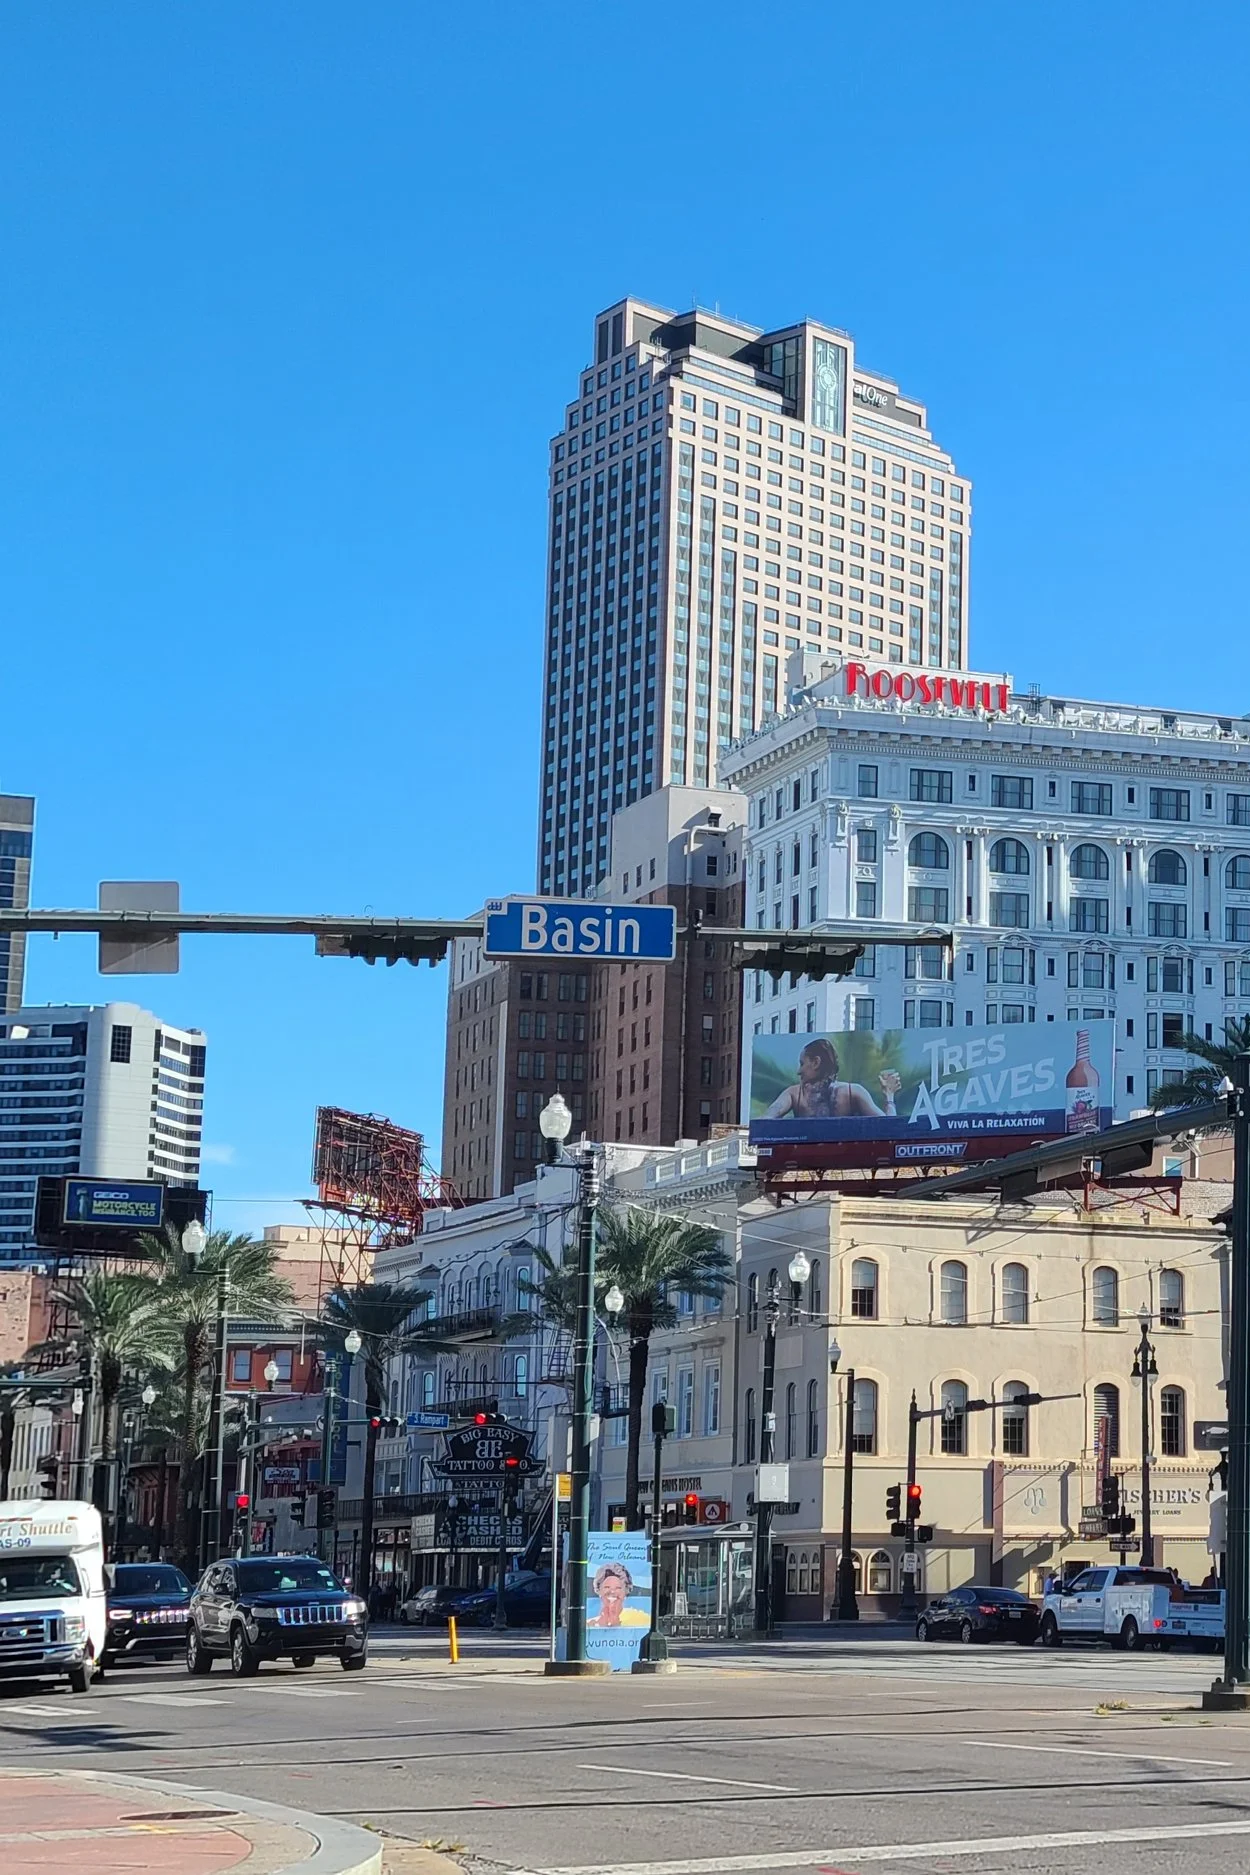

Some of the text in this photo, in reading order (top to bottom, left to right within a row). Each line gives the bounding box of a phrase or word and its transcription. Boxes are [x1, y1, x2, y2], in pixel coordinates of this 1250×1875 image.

[845, 662, 1010, 714] ROOSEVELT
[520, 904, 641, 954] Basin
[922, 1034, 1006, 1093] TRES
[908, 1057, 1056, 1131] AGAVES
[947, 1115, 1045, 1129] VIVA LA RELAXATIÓN
[898, 1144, 964, 1156] OUTFRONT
[93, 1191, 129, 1200] GEICO
[93, 1200, 156, 1210] MOTORCYCLE
[420, 1413, 445, 1427] Rampart
[460, 1429, 482, 1444] BIG
[447, 1460, 494, 1471] TATTOO
[638, 1481, 649, 1494] EW
[1118, 1488, 1200, 1504] ISHER'S
[1083, 1507, 1103, 1516] LOANS
[456, 1515, 523, 1525] CHECS
[19, 1521, 72, 1536] Shuttle
[470, 1536, 492, 1546] DEBIT
[495, 1536, 522, 1546] CRDS
[602, 1542, 621, 1551] Soul
